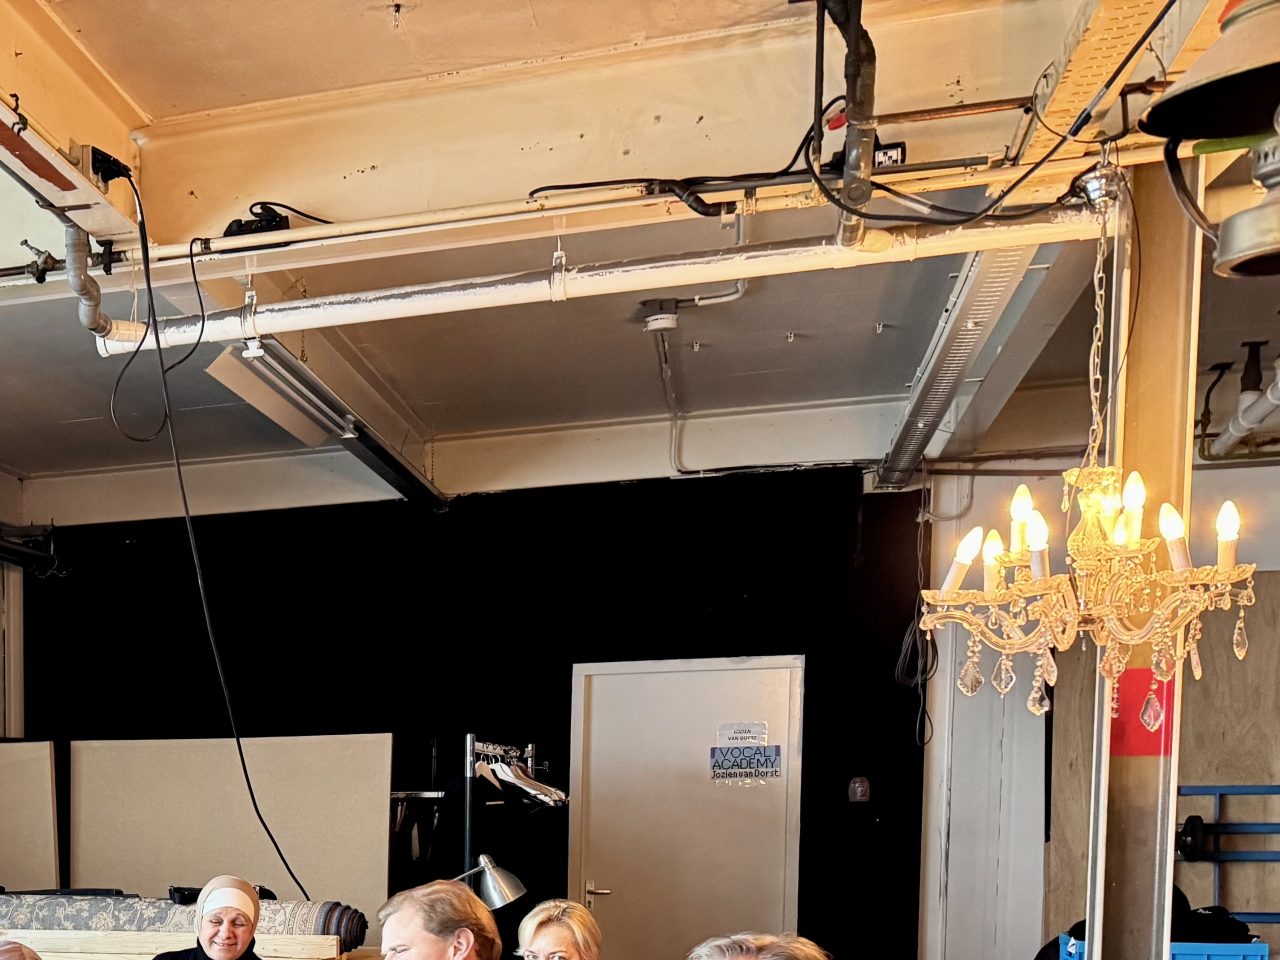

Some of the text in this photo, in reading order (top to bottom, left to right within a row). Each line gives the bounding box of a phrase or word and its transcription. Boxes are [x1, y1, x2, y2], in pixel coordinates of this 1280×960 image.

[719, 747, 771, 758] VOCAL
[712, 758, 777, 770] ACADEMY
[711, 769, 738, 779] Jozien
[754, 769, 780, 778] Dorst
